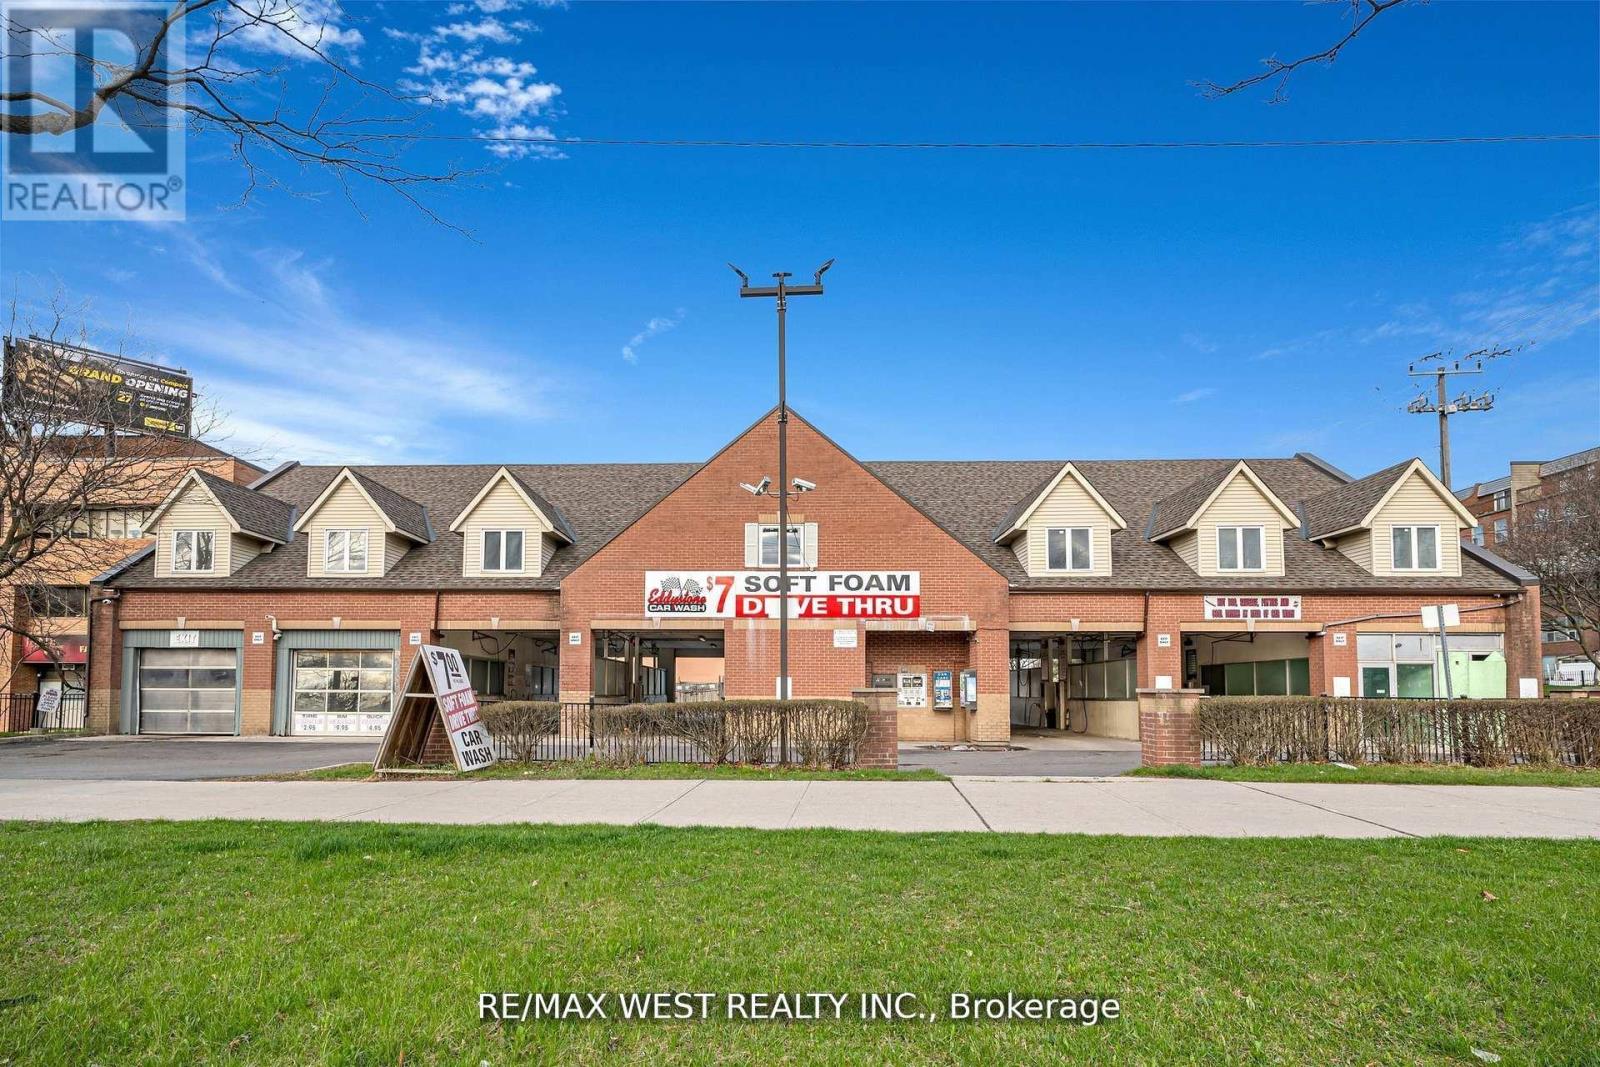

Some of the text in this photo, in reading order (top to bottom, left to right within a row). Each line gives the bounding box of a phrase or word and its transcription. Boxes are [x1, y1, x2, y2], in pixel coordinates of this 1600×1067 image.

[68, 365, 123, 384] GRAND
[125, 378, 189, 398] OPENING
[744, 574, 911, 593] SOFT FOAM
[649, 604, 706, 612] CAR WASH
[742, 596, 914, 615] DVE THRU
[461, 729, 483, 748] CAR
[462, 746, 493, 767] WASH
